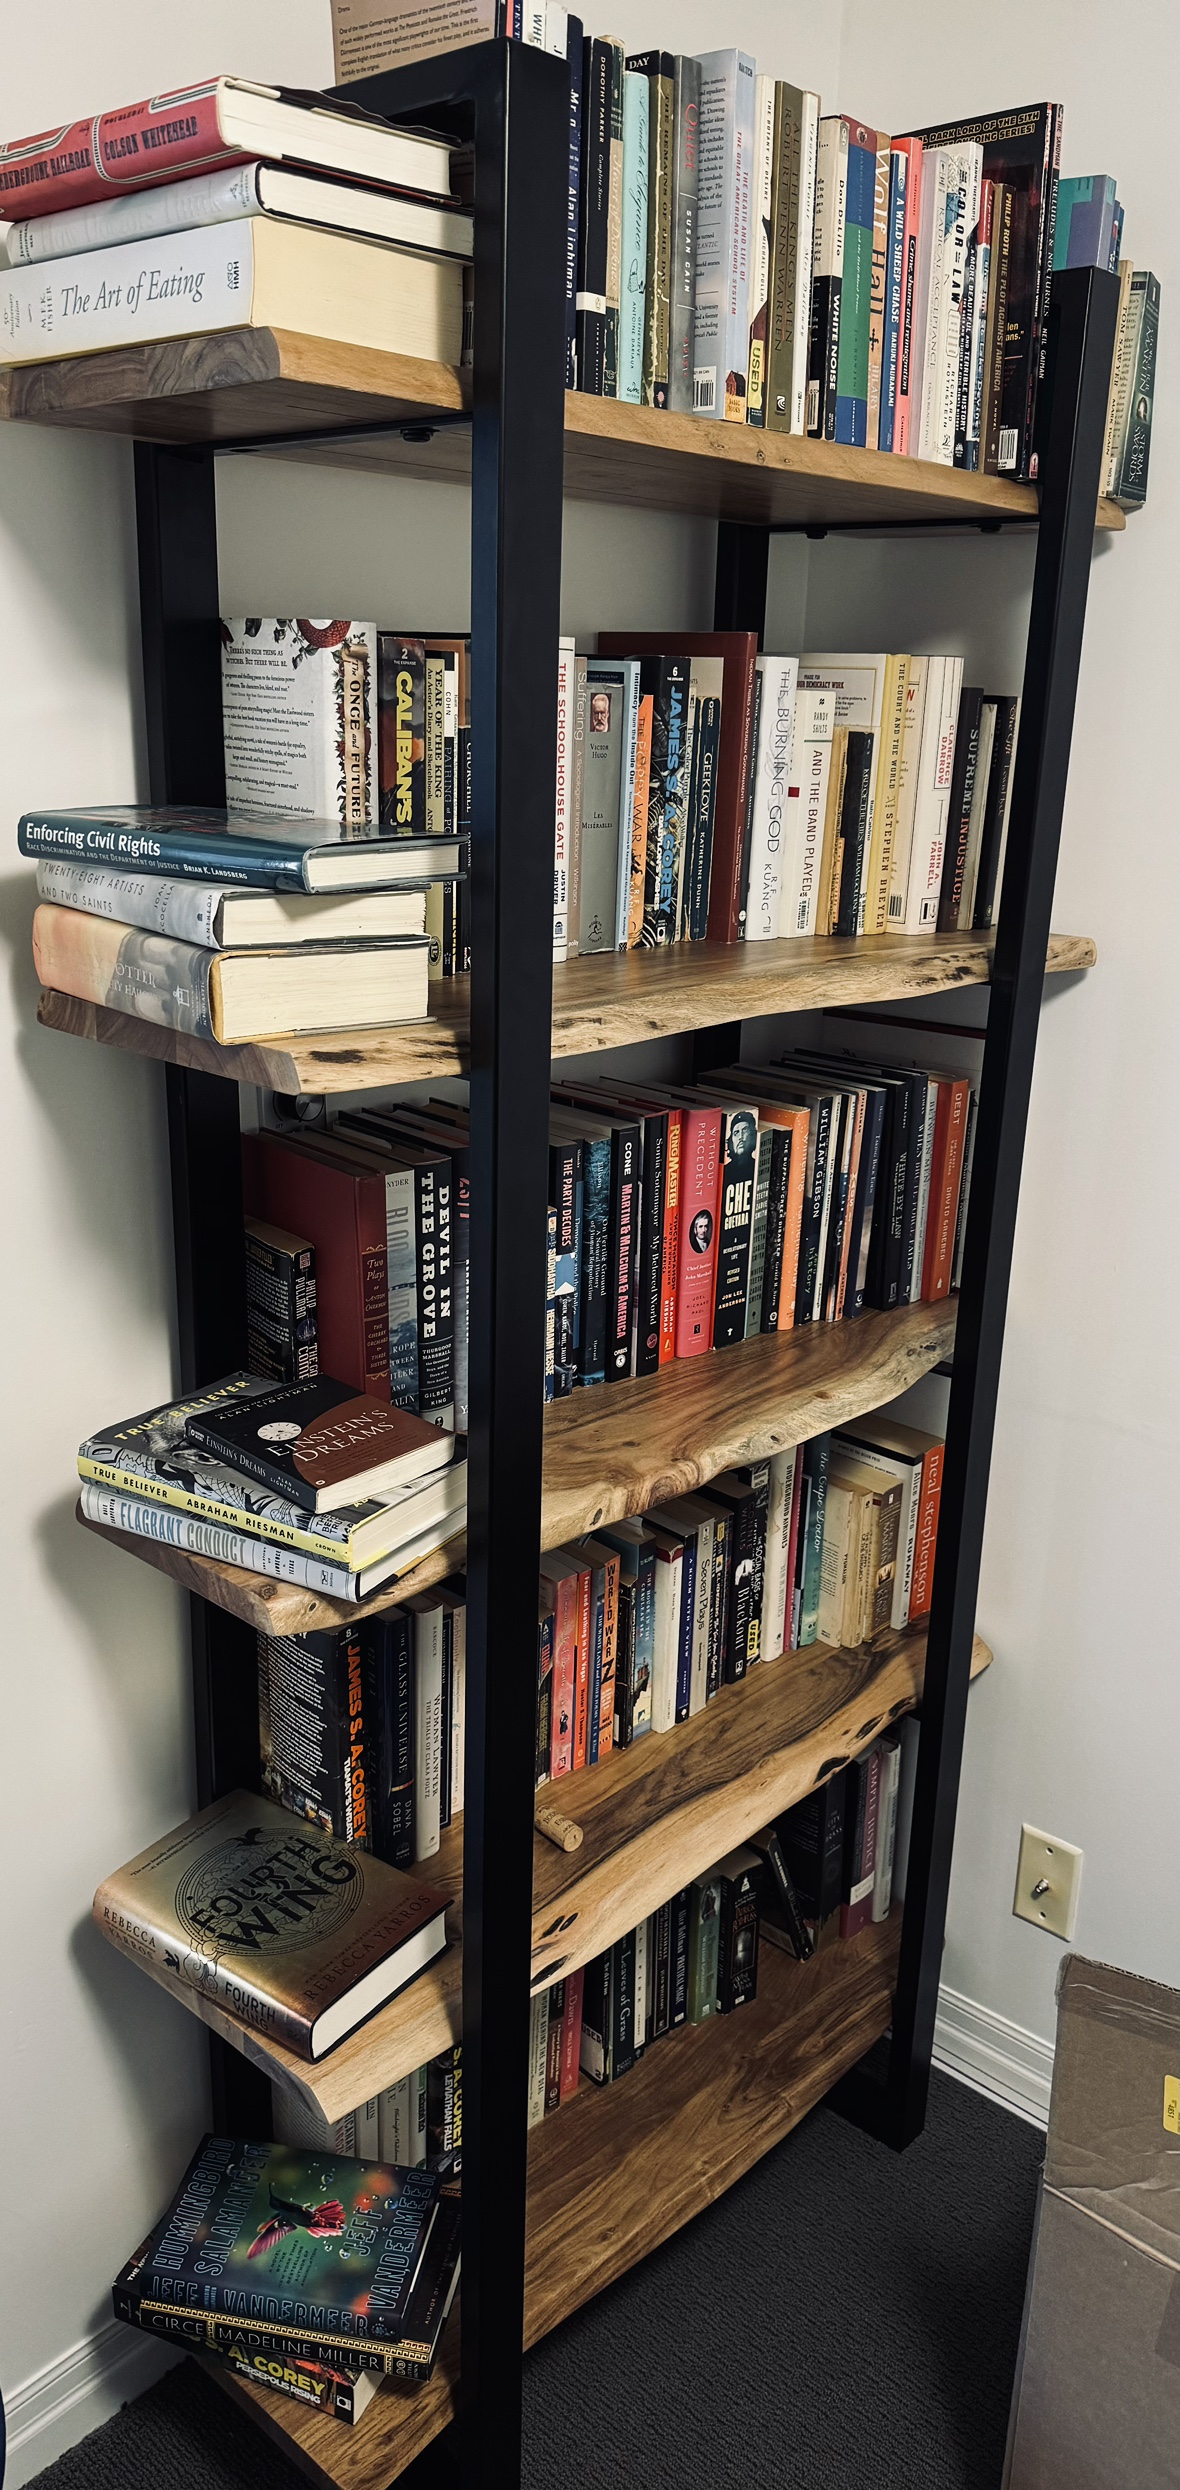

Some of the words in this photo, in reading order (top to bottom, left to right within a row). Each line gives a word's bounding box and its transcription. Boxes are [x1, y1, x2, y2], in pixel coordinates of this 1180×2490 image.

[629, 57, 649, 69] DAY
[104, 133, 139, 161] COLSON
[141, 116, 198, 149] WHITEHEAD
[684, 103, 699, 170] Quiet
[930, 127, 955, 144] DARK
[956, 122, 980, 140] LORD
[982, 120, 996, 136] OF
[998, 116, 1016, 132] THE
[1018, 110, 1040, 128] SITH
[1000, 124, 1035, 140] SERIES!
[50, 148, 91, 176] RAILROAD
[782, 108, 792, 190] ROBERT
[874, 149, 890, 236] Wolf
[1004, 193, 1012, 227] PHILIP
[1050, 178, 1058, 234] PRELUDES
[779, 201, 788, 256] PENN
[895, 211, 904, 241] WILD
[955, 187, 966, 248] COLOR
[893, 244, 903, 283] SHEEP
[1002, 229, 1010, 256] ROTH
[62, 284, 89, 316] The
[93, 281, 122, 311] Art
[127, 270, 146, 314] of
[147, 266, 205, 302] Eating
[870, 249, 886, 317] Hall
[892, 285, 900, 324] CHASE
[951, 269, 961, 307] LAW
[1044, 252, 1053, 317] NOCTURNES
[774, 268, 786, 352] WARREN
[832, 295, 840, 341] WHITE
[751, 347, 760, 393] USED
[830, 345, 838, 390] NOISE
[435, 669, 443, 706] YEAR
[558, 663, 567, 693] THE
[777, 669, 790, 702] THE
[350, 680, 361, 730] ONCE
[434, 710, 442, 731] OF
[574, 671, 587, 741] Suffering
[351, 733, 359, 749] and
[396, 670, 412, 823] CALIBAN'S
[434, 734, 442, 761] THE
[590, 743, 609, 751] VICTOR
[667, 686, 683, 769] JAMES
[557, 700, 566, 816] SCHOOLHOUSE
[592, 751, 607, 759] HUGO
[770, 708, 789, 796] BURNING
[811, 750, 822, 776] AND
[961, 728, 979, 815] SUPREME
[351, 753, 361, 818] FUTURE
[434, 762, 442, 798] KING
[664, 773, 677, 797] S.
[809, 781, 820, 804] THE
[26, 822, 84, 849] Enforcing
[86, 830, 115, 851] Civil
[118, 836, 161, 857] Rights
[556, 822, 565, 860] GATE
[582, 821, 612, 829] MISÉRABLES
[663, 811, 676, 836] A.
[767, 805, 782, 853] GOD
[806, 808, 818, 843] BAND
[882, 812, 893, 872] STEPHEN
[43, 862, 105, 886] TWENTY-EIGHT
[107, 879, 145, 896] ARTISTS
[660, 849, 678, 913] COREY
[801, 847, 815, 892] PLAYED
[952, 818, 970, 903] INJUSTICE
[41, 886, 57, 899] AND
[60, 890, 78, 904] TWO
[82, 894, 113, 913] SAINTS
[875, 879, 888, 929] BREYER
[953, 1092, 963, 1125] DEBT
[707, 1127, 717, 1188] WITHOUT
[817, 1108, 829, 1166] WILLIAM
[563, 1157, 573, 1178] THE
[623, 1142, 632, 1176] CONE
[666, 1124, 681, 1208] RINGMASTER
[695, 1122, 706, 1197] PRECEDENT
[421, 1172, 434, 1234] THE
[562, 1179, 573, 1207] PARTY
[621, 1183, 632, 1225] MARTIN
[724, 1179, 752, 1216] CHE
[812, 1170, 823, 1219] GIBSON
[439, 1185, 450, 1275] DEVIL
[561, 1209, 572, 1248] DECIDES
[724, 1212, 749, 1231] GUEVARA
[619, 1234, 630, 1284] MALCOLM
[422, 1242, 436, 1338] GROVE
[440, 1287, 450, 1318] IN
[617, 1295, 628, 1339] AMERICA
[114, 1416, 165, 1442] TRUE
[169, 1380, 251, 1419] BELIEVER
[267, 1408, 389, 1458] EINSTEIN'S
[293, 1421, 395, 1463] DREAMS
[206, 1435, 238, 1461] EINSTEIN'S
[239, 1454, 267, 1478] DREAMS
[820, 1452, 828, 1472] the
[927, 1454, 940, 1495] neal
[92, 1466, 117, 1481] TRUE
[123, 1477, 168, 1499] BELIEVER
[186, 1498, 239, 1522] ABRAHAM
[245, 1517, 295, 1541] RIESMAN
[785, 1463, 793, 1513] UNDERGROUND
[120, 1502, 183, 1545] FLAGRANT
[186, 1523, 247, 1565] CONDUCT
[782, 1513, 790, 1549] AIRLINES
[814, 1510, 825, 1553] Doctor
[916, 1500, 936, 1604] stephenson
[699, 1558, 711, 1598] Seven
[903, 1538, 914, 1593] RUNAWAY
[605, 1563, 616, 1622] WORLD
[698, 1599, 708, 1630] Plays
[735, 1586, 750, 1651] Blackout
[605, 1623, 614, 1659] WAR
[748, 1623, 757, 1651] USED
[347, 1645, 362, 1717] JAMES
[398, 1651, 408, 1697] GLASS
[600, 1657, 615, 1685] Z
[350, 1717, 363, 1741] S.
[398, 1701, 408, 1774] UNIVERSE
[350, 1744, 364, 1768] A.
[351, 1768, 367, 1839] COREY
[392, 1801, 401, 1835] SOBEL
[404, 1800, 412, 1829] DAVA
[189, 1837, 322, 1933] FOURTH
[216, 1855, 356, 1951] WING
[103, 1906, 156, 1948] REBECCA
[224, 1981, 276, 2024] FOURTH
[233, 2002, 269, 2032] WING
[444, 2074, 453, 2123] LEVIATHAN
[444, 2124, 453, 2152] FALLS
[152, 2137, 235, 2271] HUMMINGBIRD
[194, 2142, 273, 2276] SALAMANDER
[356, 2206, 384, 2257] JEFF
[366, 2171, 437, 2310] VANDERMEER
[147, 2276, 198, 2307] JEFF
[223, 2288, 369, 2338] VANDERMEER
[152, 2314, 205, 2335] CIRCE
[219, 2327, 311, 2357] MADELINE
[318, 2346, 379, 2370] MILLER
[235, 2361, 290, 2391] PERSEPOLIS
[290, 2384, 321, 2405] RISING
[253, 2356, 326, 2396] COREY
